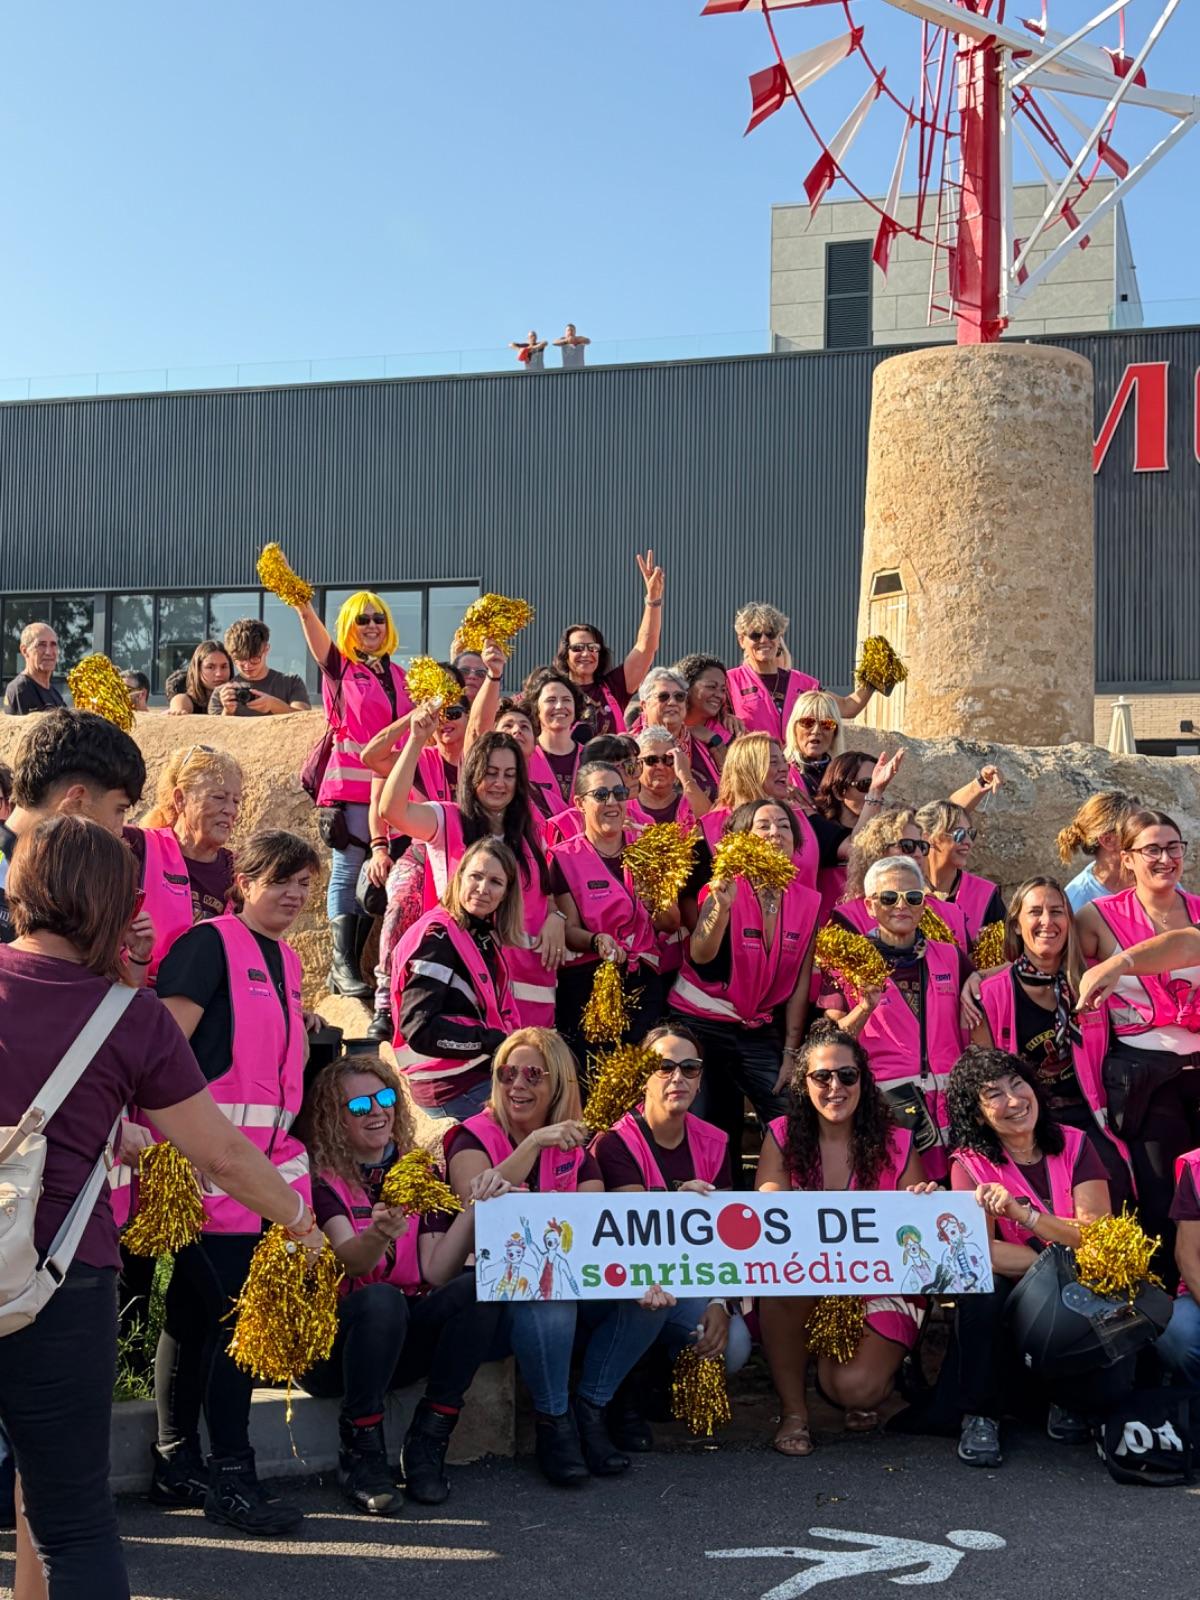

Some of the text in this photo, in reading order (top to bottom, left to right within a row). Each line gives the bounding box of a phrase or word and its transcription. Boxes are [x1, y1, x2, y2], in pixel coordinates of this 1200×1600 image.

[1092, 361, 1200, 474] M
[592, 1203, 879, 1250] AMIGOS DE
